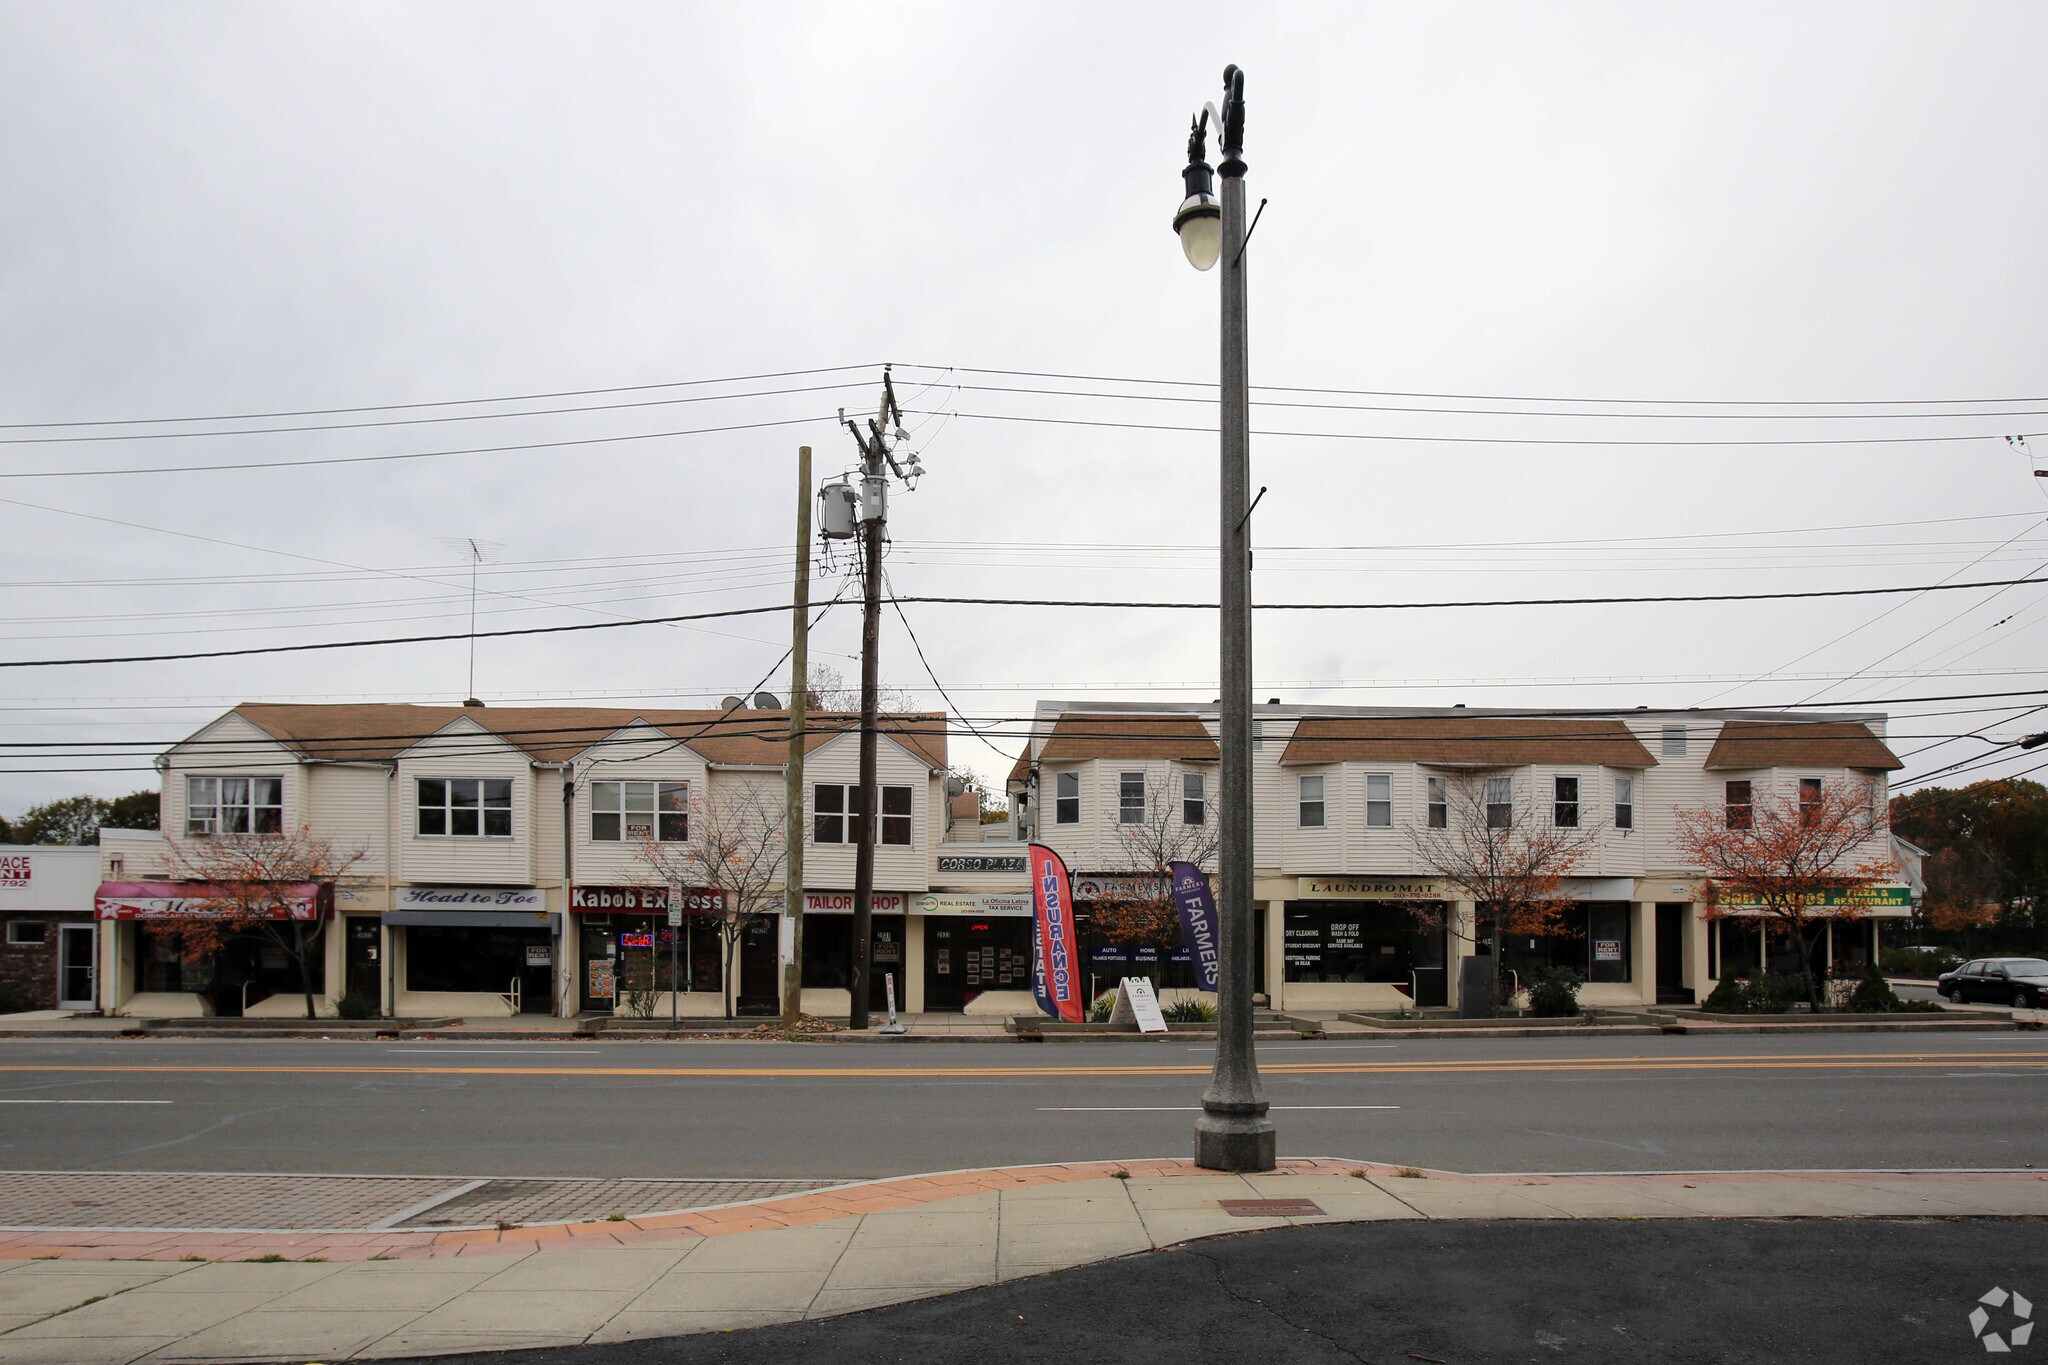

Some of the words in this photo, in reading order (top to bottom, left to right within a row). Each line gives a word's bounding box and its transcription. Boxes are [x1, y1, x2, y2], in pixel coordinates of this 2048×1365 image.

[0, 857, 30, 869] ACE
[941, 858, 982, 869] CORSO
[985, 858, 1024, 870] PLAZA
[1175, 881, 1204, 892] FARMERS
[1311, 884, 1435, 892] LAUNDROMAT
[404, 889, 468, 903] Head
[471, 892, 492, 903] to
[495, 891, 538, 904] Toe
[572, 888, 636, 908] Kabob
[642, 889, 723, 909] Exess
[1881, 889, 1889, 897] &
[807, 896, 852, 909] TAILOR
[871, 896, 900, 910] HOP
[1185, 897, 1219, 985] FARMERS
